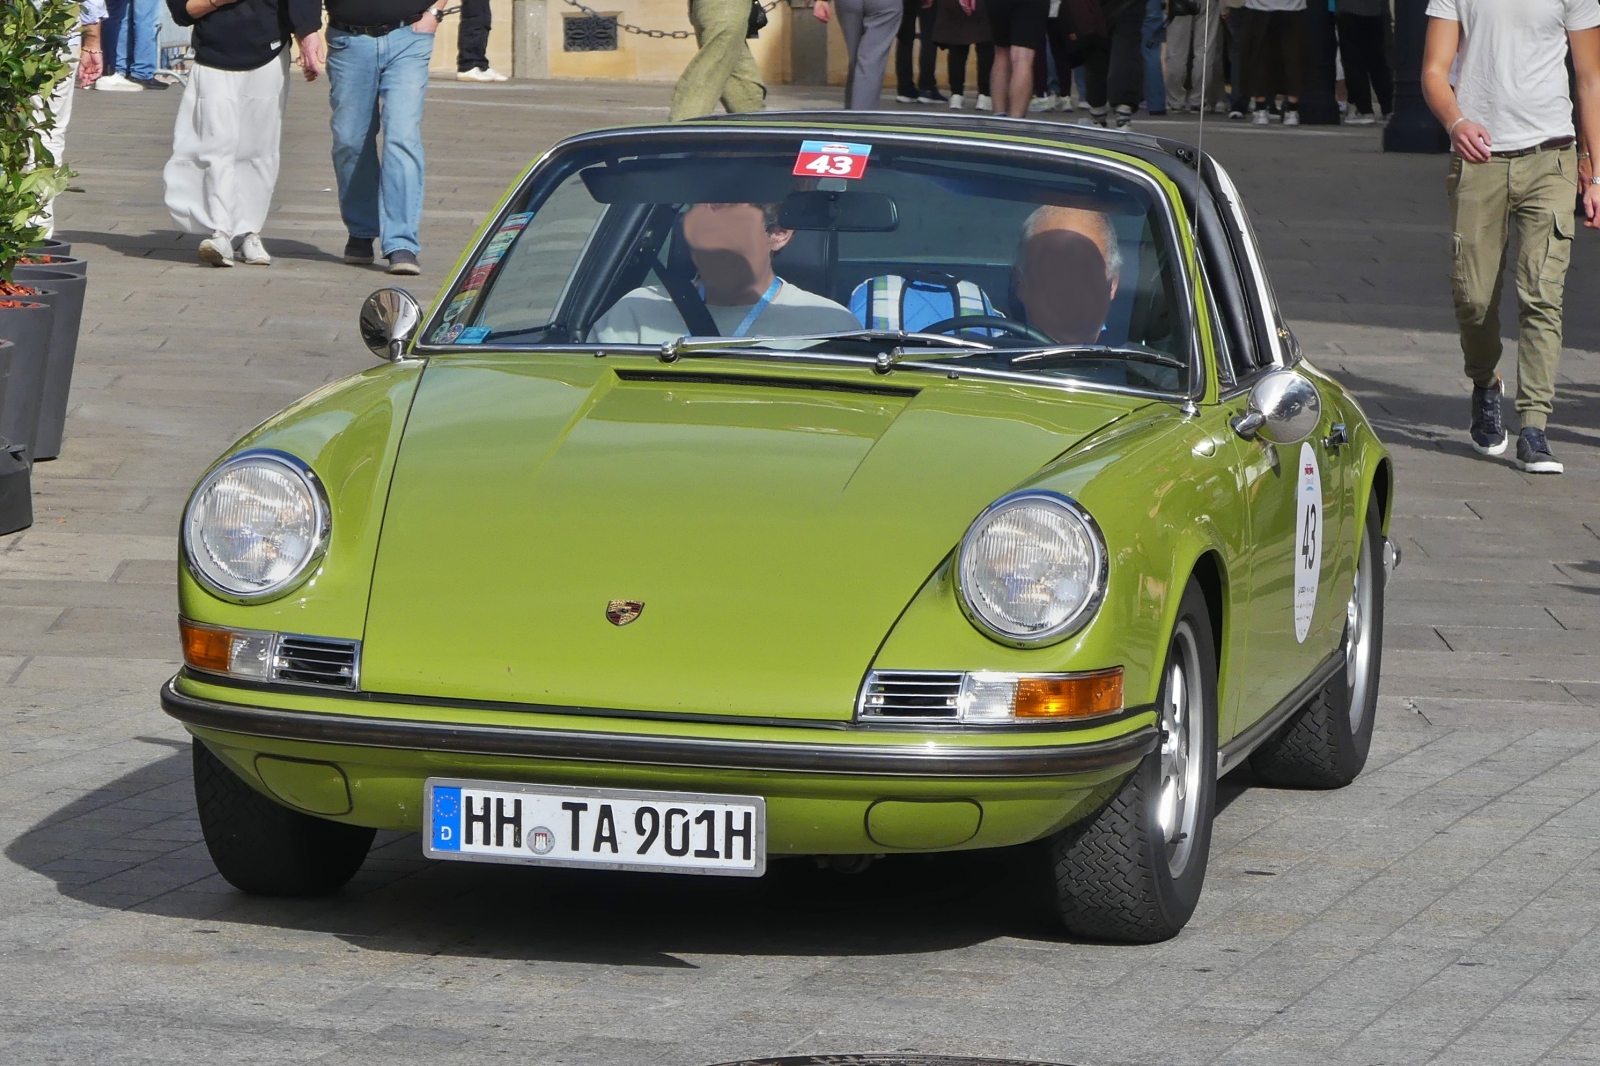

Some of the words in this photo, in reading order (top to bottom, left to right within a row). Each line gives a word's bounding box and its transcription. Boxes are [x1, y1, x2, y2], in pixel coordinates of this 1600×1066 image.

[805, 154, 853, 175] 43
[1302, 503, 1317, 570] 43
[440, 825, 452, 841] D
[464, 795, 522, 848] HH
[561, 801, 619, 854] TA
[634, 806, 752, 861] 901H
